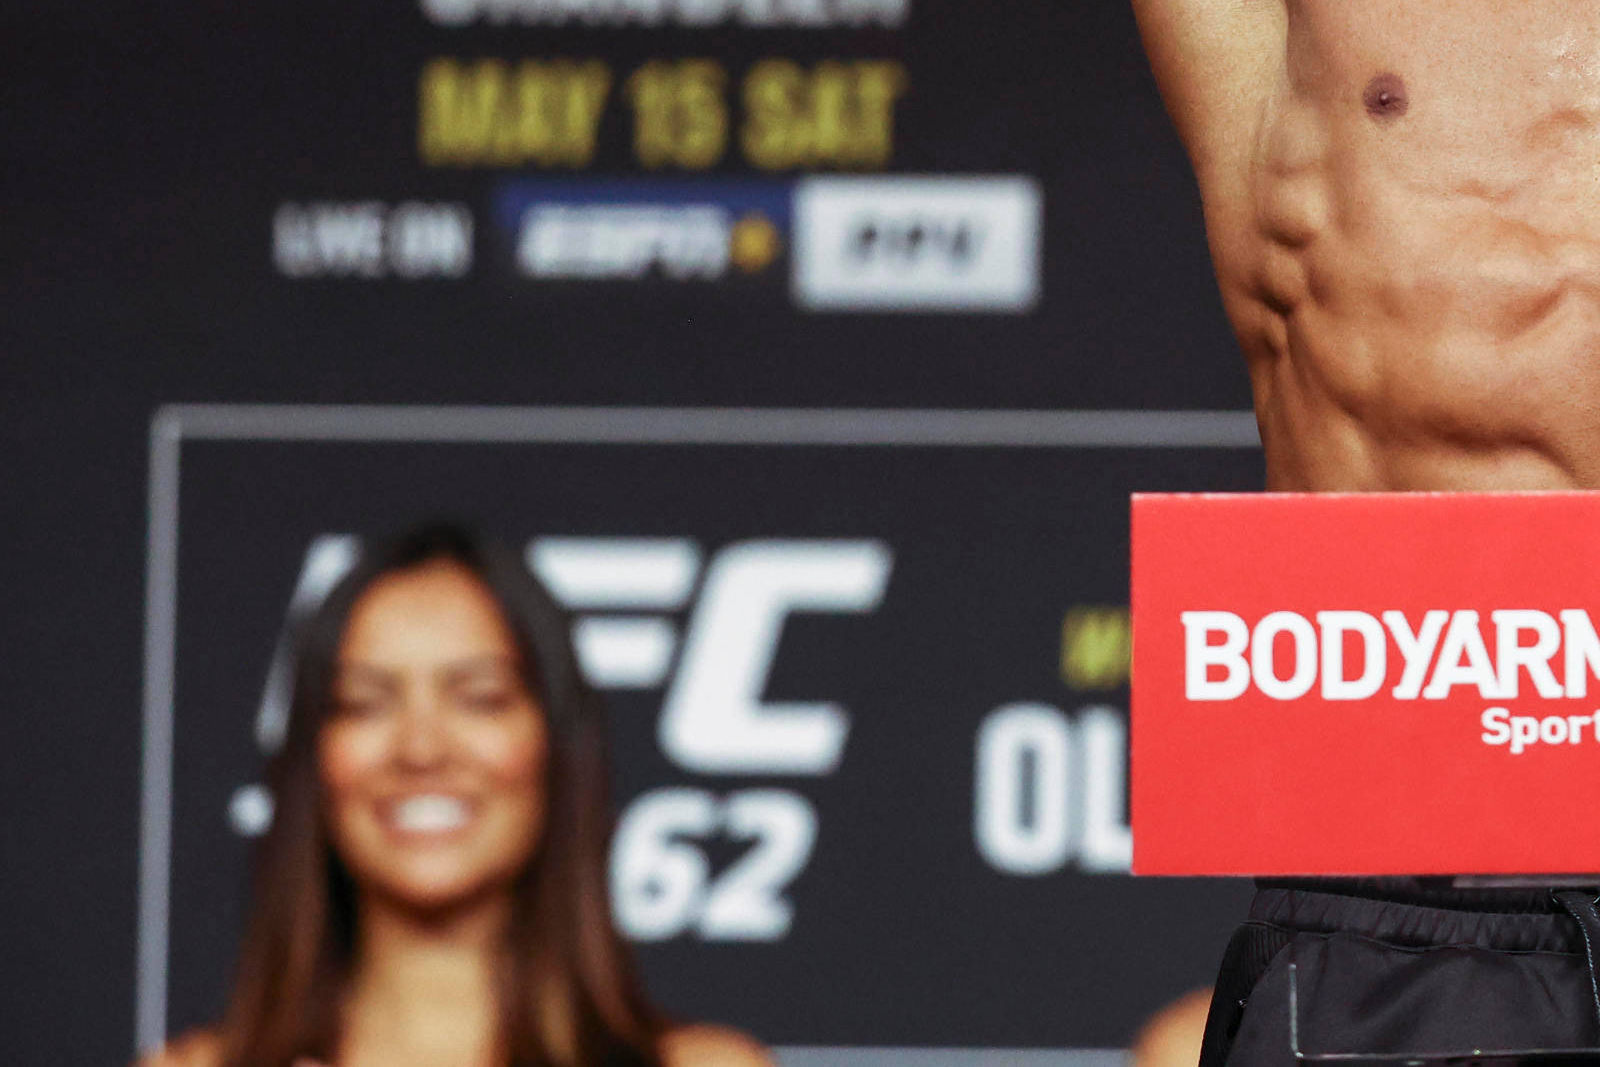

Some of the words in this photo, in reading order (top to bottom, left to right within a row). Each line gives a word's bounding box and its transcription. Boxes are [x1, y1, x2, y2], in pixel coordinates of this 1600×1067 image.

[418, 58, 610, 166] MAY
[628, 58, 729, 168] 15
[742, 58, 905, 169] SAT
